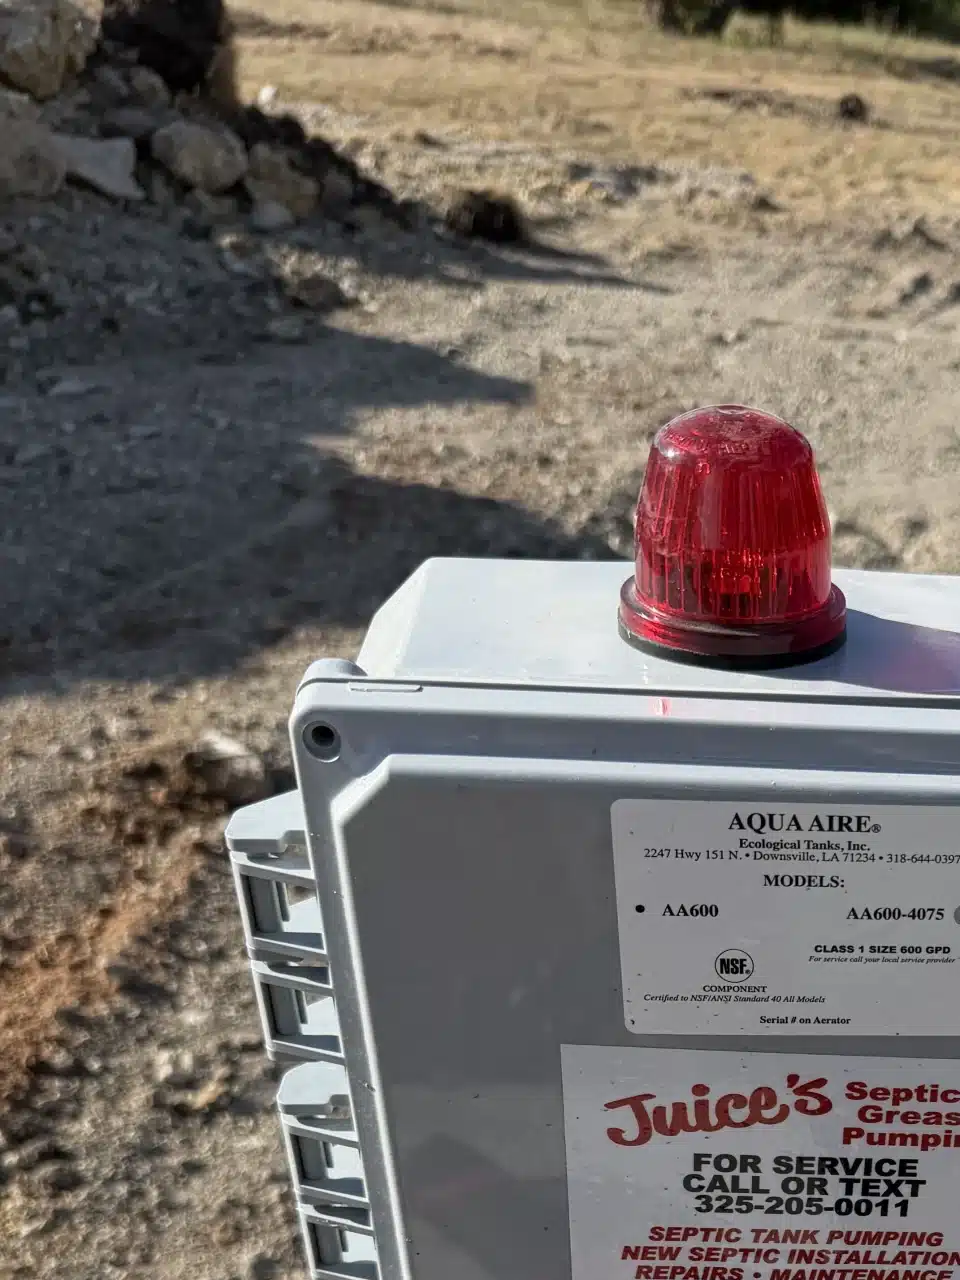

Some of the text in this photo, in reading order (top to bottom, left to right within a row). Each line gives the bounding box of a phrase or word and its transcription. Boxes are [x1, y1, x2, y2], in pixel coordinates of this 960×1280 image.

[728, 813, 803, 834] AQUA
[739, 839, 870, 852] Ecological Tanks, Inc.
[644, 849, 960, 863] 2247 Hwy 151 N. Downsville, LA 71234 318-644-0397
[764, 875, 844, 888] MODELS:
[662, 904, 718, 917] AA600
[847, 908, 944, 920] AA600-4075
[815, 945, 854, 953] CLASS
[644, 994, 679, 1002] Certified
[690, 995, 732, 1003] NSF/ANSI
[760, 1016, 788, 1024] Serial
[845, 1082, 960, 1107] Septic
[604, 1074, 832, 1146] Juice's
[694, 1153, 918, 1177] FOR SERVICE
[683, 1174, 926, 1197] CALL OR TEXT
[695, 1195, 908, 1217] 325-205-0011
[648, 1226, 944, 1246] SEPTIC TANK PUMPING
[621, 1246, 682, 1260] NEW
[688, 1247, 780, 1263] SEPTIC
[635, 1265, 744, 1280] REPAIRS
